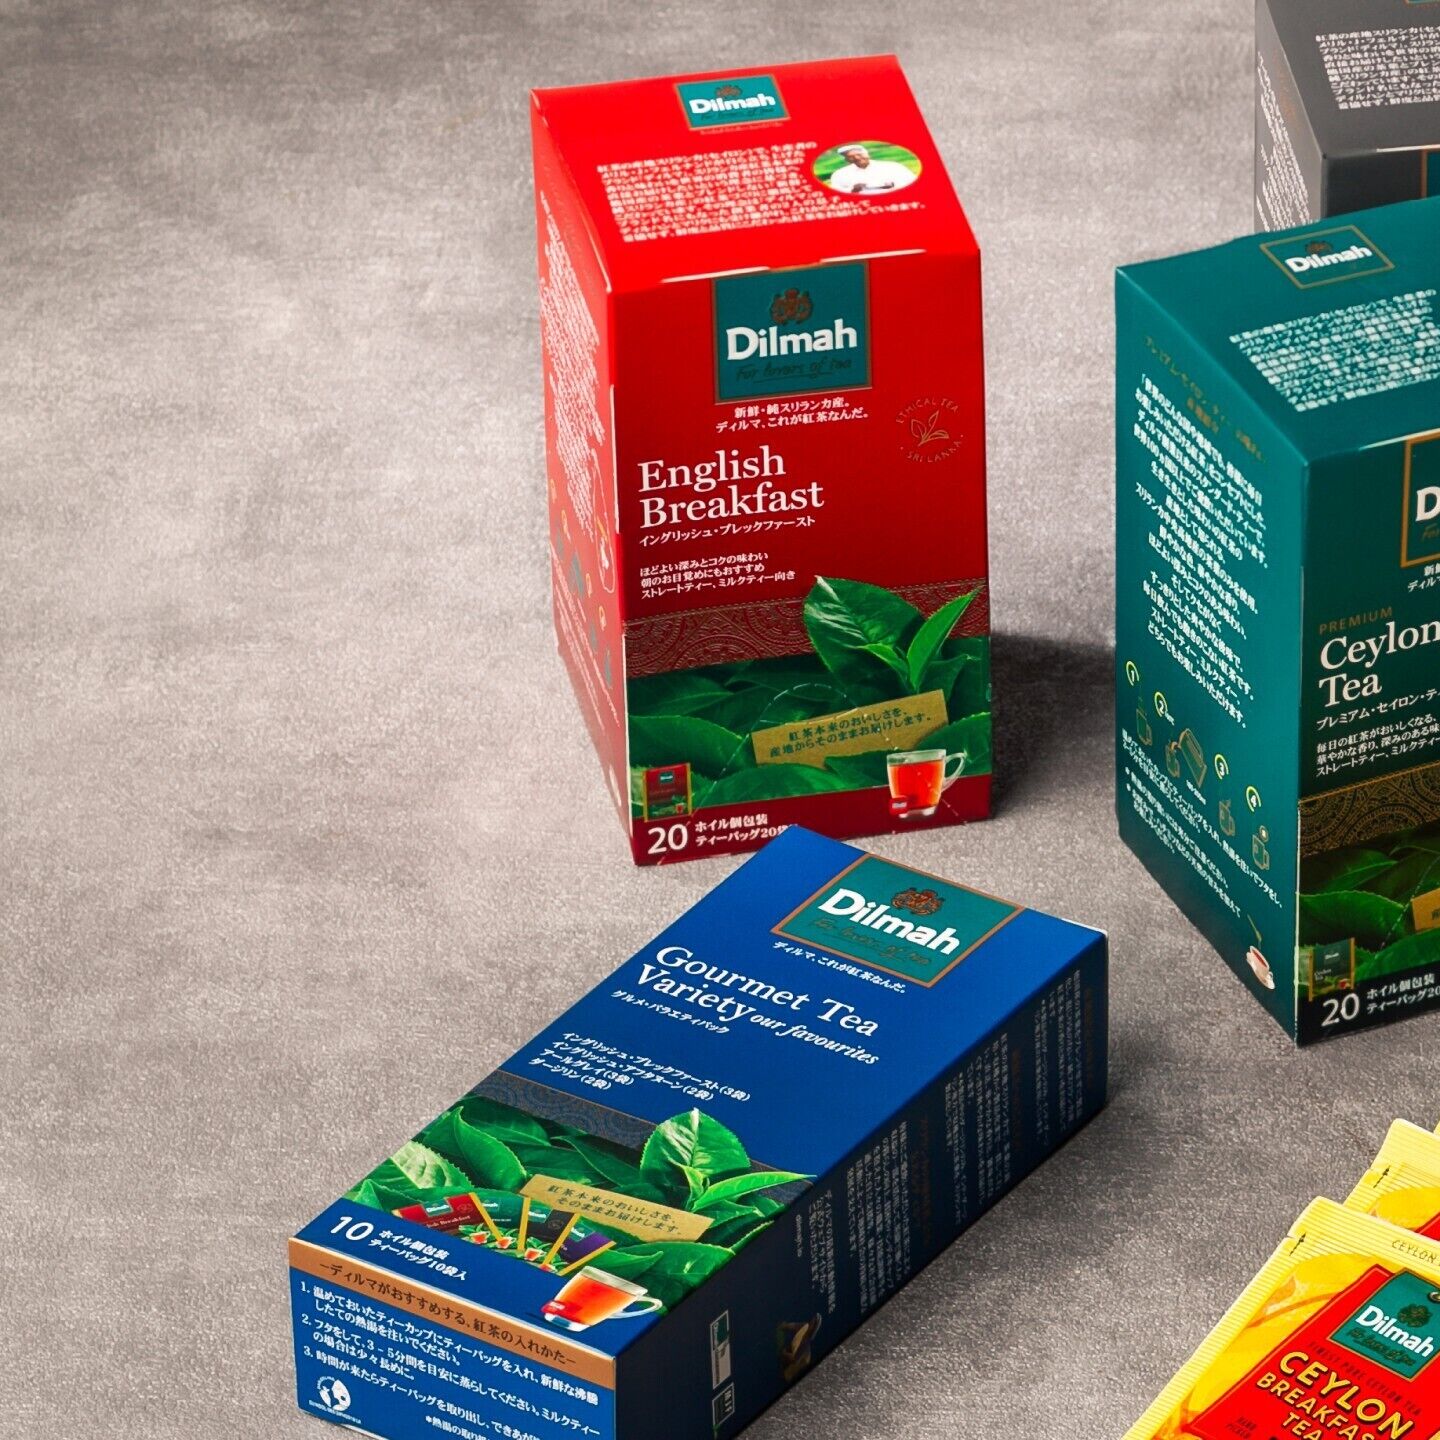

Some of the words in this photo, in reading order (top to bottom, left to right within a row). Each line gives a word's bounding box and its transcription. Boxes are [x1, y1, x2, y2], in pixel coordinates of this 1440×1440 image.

[690, 92, 776, 114] Dilmah
[1285, 245, 1372, 273] Dilmah
[726, 318, 858, 361] Dilmah
[716, 408, 868, 433] ディルマ、これが紅茶なんだ。
[734, 399, 850, 419] 新鮮・純スリランカ産。
[638, 445, 786, 492] English
[639, 480, 824, 529] Breakfast
[639, 516, 816, 547] イングリッシュ・ブレックファースト
[640, 552, 769, 577] ほどよい深みとコクの味わい
[640, 562, 765, 588] 朝のお目覚めにもおすすめ
[641, 570, 796, 600] ストレートティー、ミルクティー向き
[1318, 607, 1393, 634] PREMIUM
[1318, 672, 1382, 708] Tea
[770, 714, 932, 758] 産地からそのままお届けします。
[788, 708, 908, 742] 紅茶本来のおいしさを、
[648, 823, 688, 854] 20
[695, 814, 768, 833] ホイル個包装
[818, 888, 961, 954] Dilmah
[772, 941, 906, 994] ディルマ、これが紅茶なんだ。
[656, 946, 810, 1010] Gourmet
[817, 998, 880, 1037] Tea
[1366, 973, 1435, 1000] ホイル個包装
[610, 990, 730, 1035] グルメ・バラエティパック
[637, 964, 754, 1022] Variety
[750, 1013, 786, 1037] our
[780, 1024, 879, 1066] favourites
[1321, 992, 1360, 1027] 20
[528, 1058, 612, 1090] ダージリン(2袋)
[540, 1048, 634, 1085] アールグレイ(3袋)
[562, 1032, 751, 1102] イングリッシュ・ブレックファースト(3袋)
[329, 1215, 376, 1242] 10
[378, 1228, 451, 1260] ホイル個包装
[368, 1238, 467, 1282] ティーバッグ10袋入
[1391, 1239, 1436, 1266] CEYLON
[302, 1314, 312, 1328] 2.
[315, 1300, 461, 1367] したての熱湯を注いでください。
[1356, 1305, 1434, 1357] Dilmah
[300, 1281, 310, 1295] 1.
[313, 1286, 599, 1406] 温めておいたティーカップにティーバッグを入れ、新鮮な沸騰
[303, 1345, 314, 1358] 3.
[313, 1331, 416, 1381] の場合は少々長めに。
[1279, 1351, 1414, 1440] CEYLON
[1282, 1412, 1323, 1440] TEA
